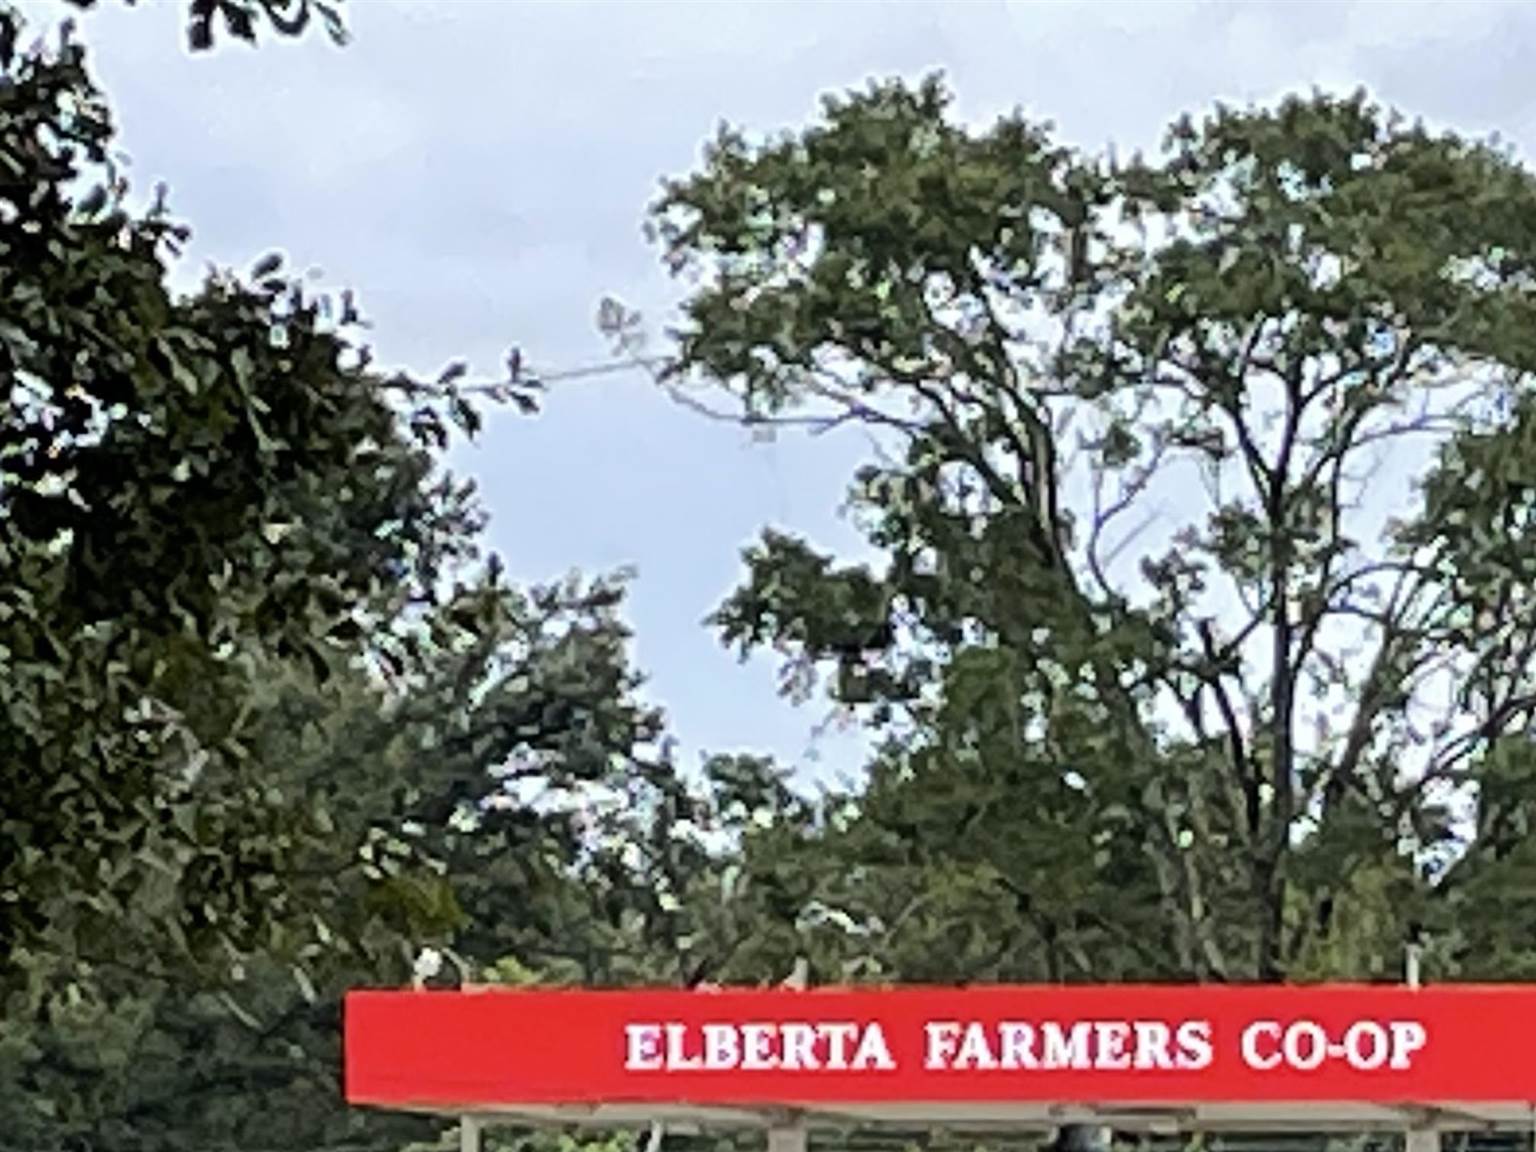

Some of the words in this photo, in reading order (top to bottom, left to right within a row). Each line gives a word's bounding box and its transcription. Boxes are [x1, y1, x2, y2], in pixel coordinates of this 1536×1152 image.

[624, 1021, 897, 1071] ELBERTA
[924, 1021, 1213, 1071] FARMERS
[1239, 1021, 1427, 1070] CO-OP
